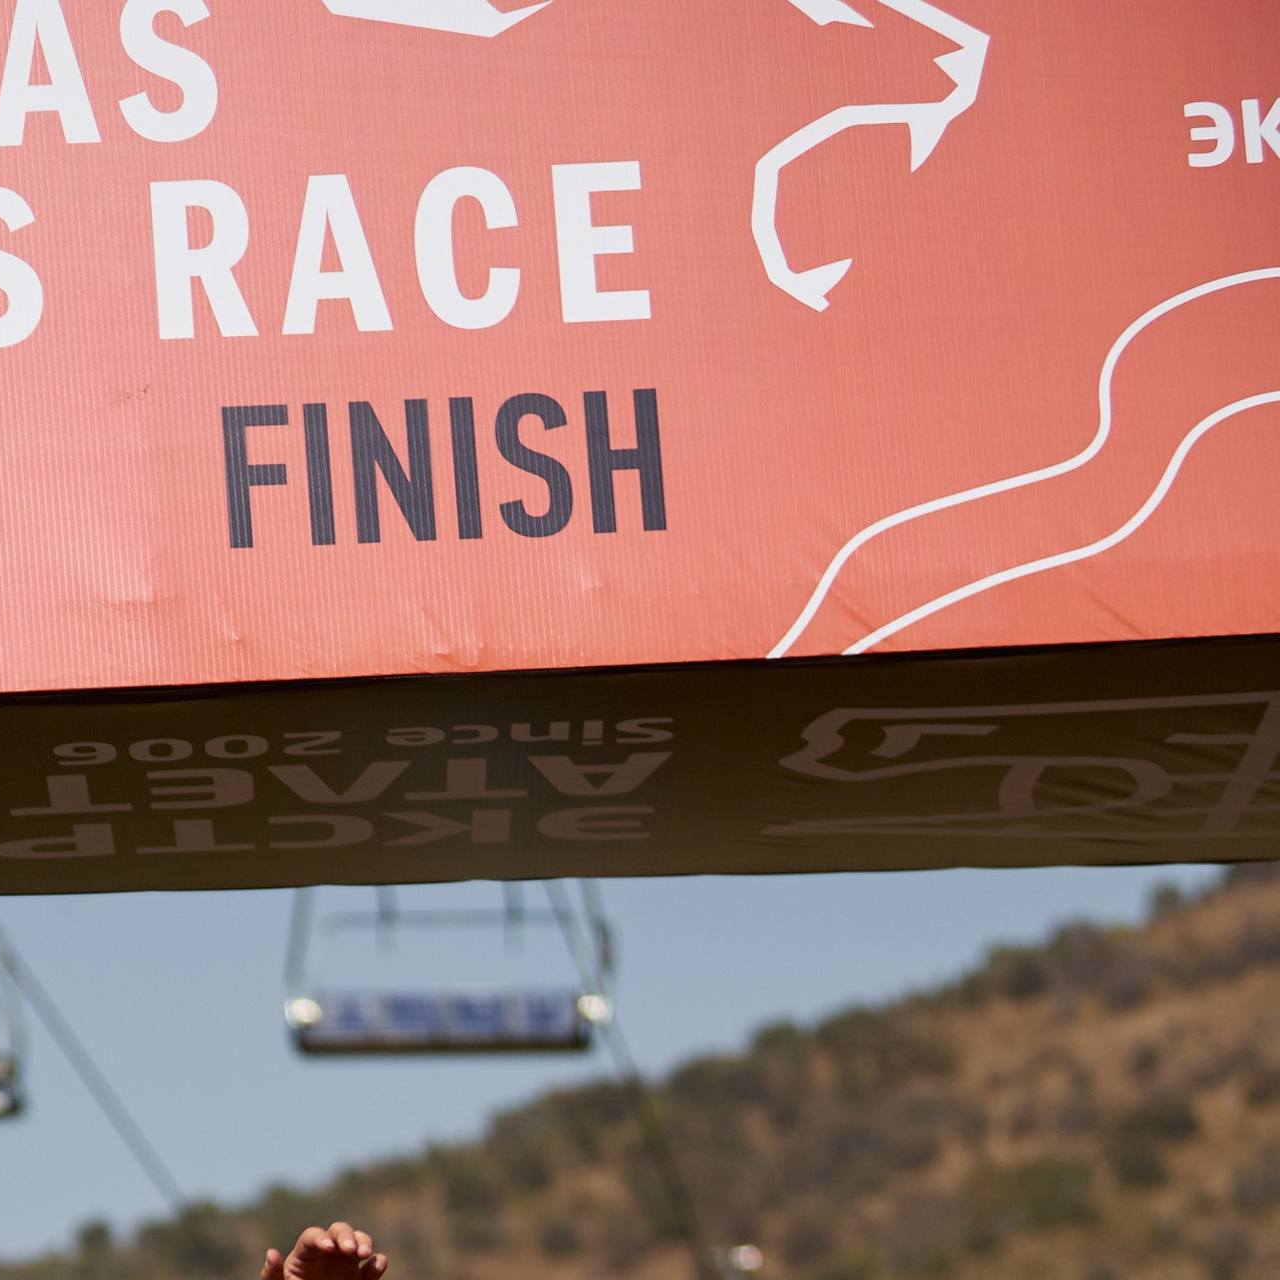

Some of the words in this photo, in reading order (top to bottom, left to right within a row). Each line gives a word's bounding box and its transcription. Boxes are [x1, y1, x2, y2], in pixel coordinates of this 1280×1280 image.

[149, 160, 652, 341] RACE
[221, 388, 669, 549] FINISH
[51, 730, 343, 767] 2006
[386, 715, 676, 750] Since
